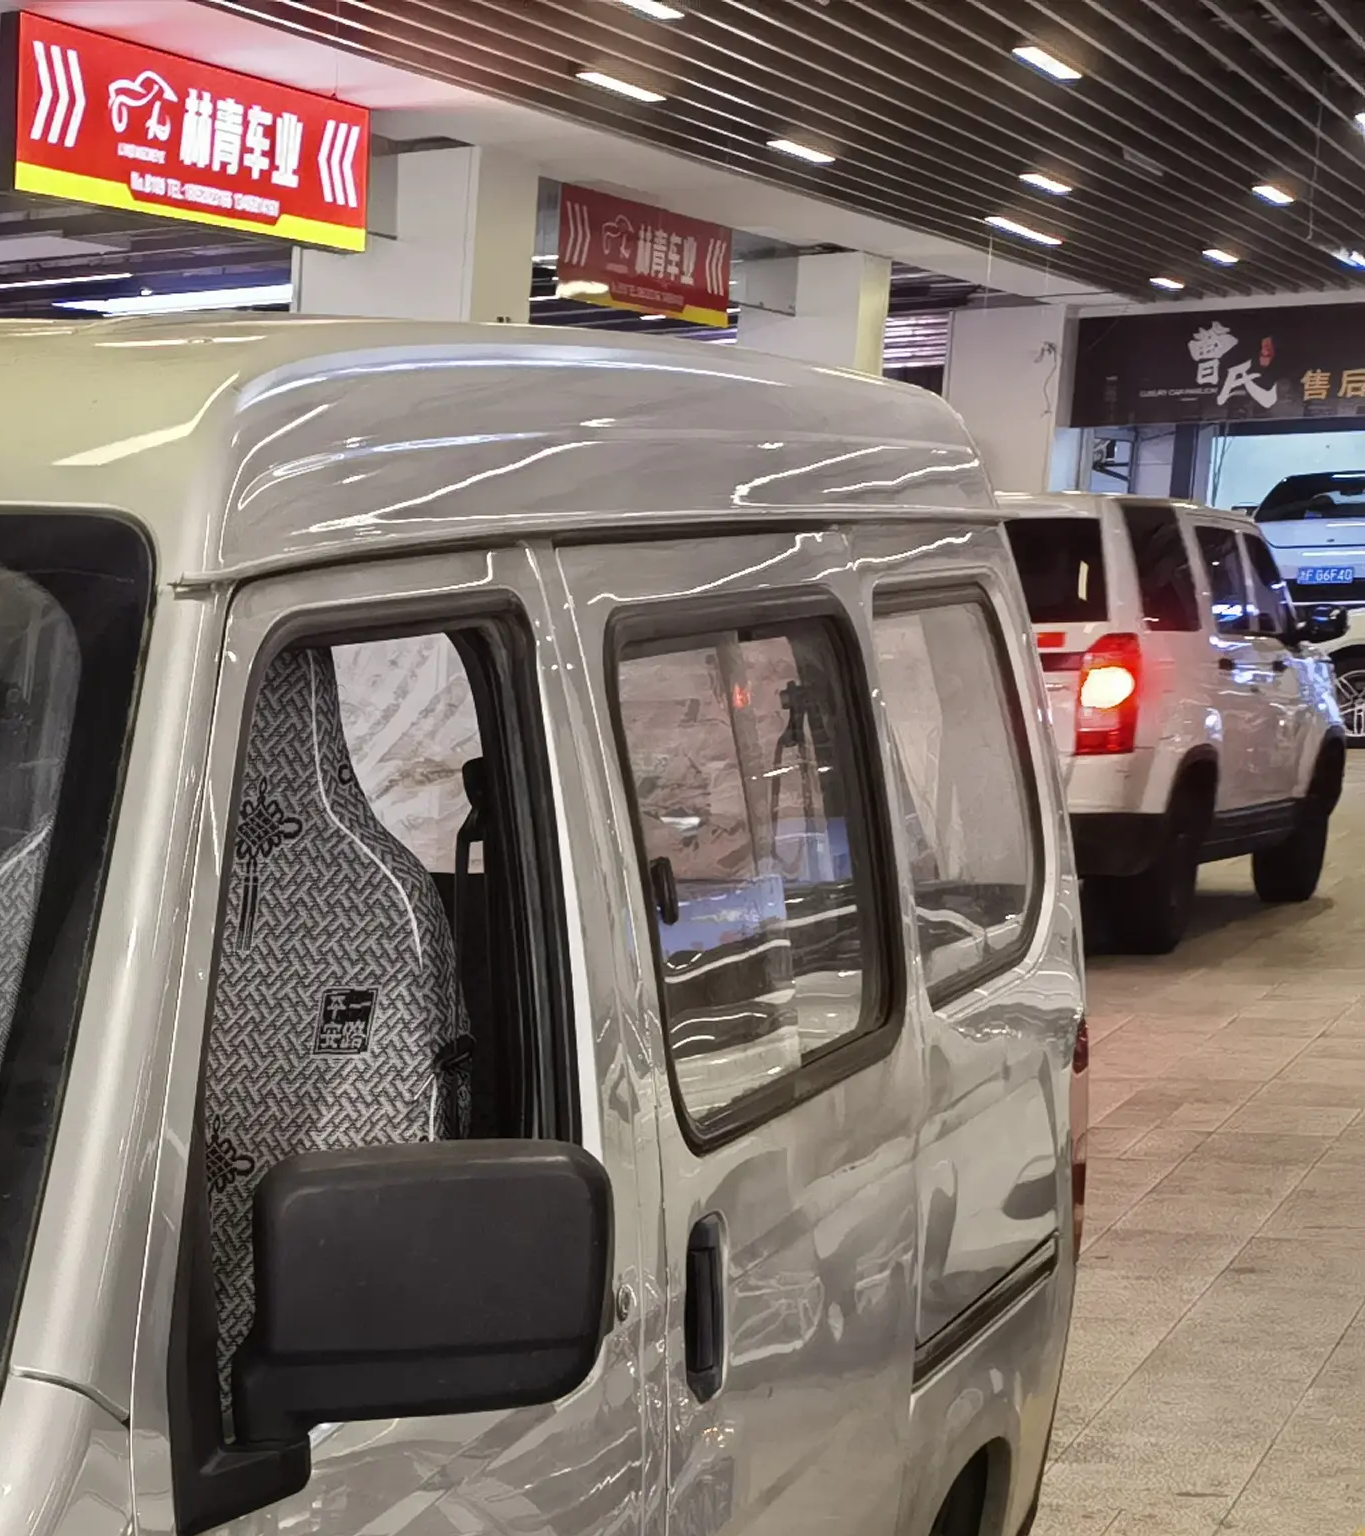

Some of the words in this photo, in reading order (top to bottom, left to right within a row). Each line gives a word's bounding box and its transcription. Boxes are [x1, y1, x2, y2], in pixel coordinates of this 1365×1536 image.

[180, 88, 303, 188] 林青车业
[635, 224, 697, 287] 林青车业
[1188, 321, 1277, 408] 曹氏
[1300, 368, 1365, 401] 售后
